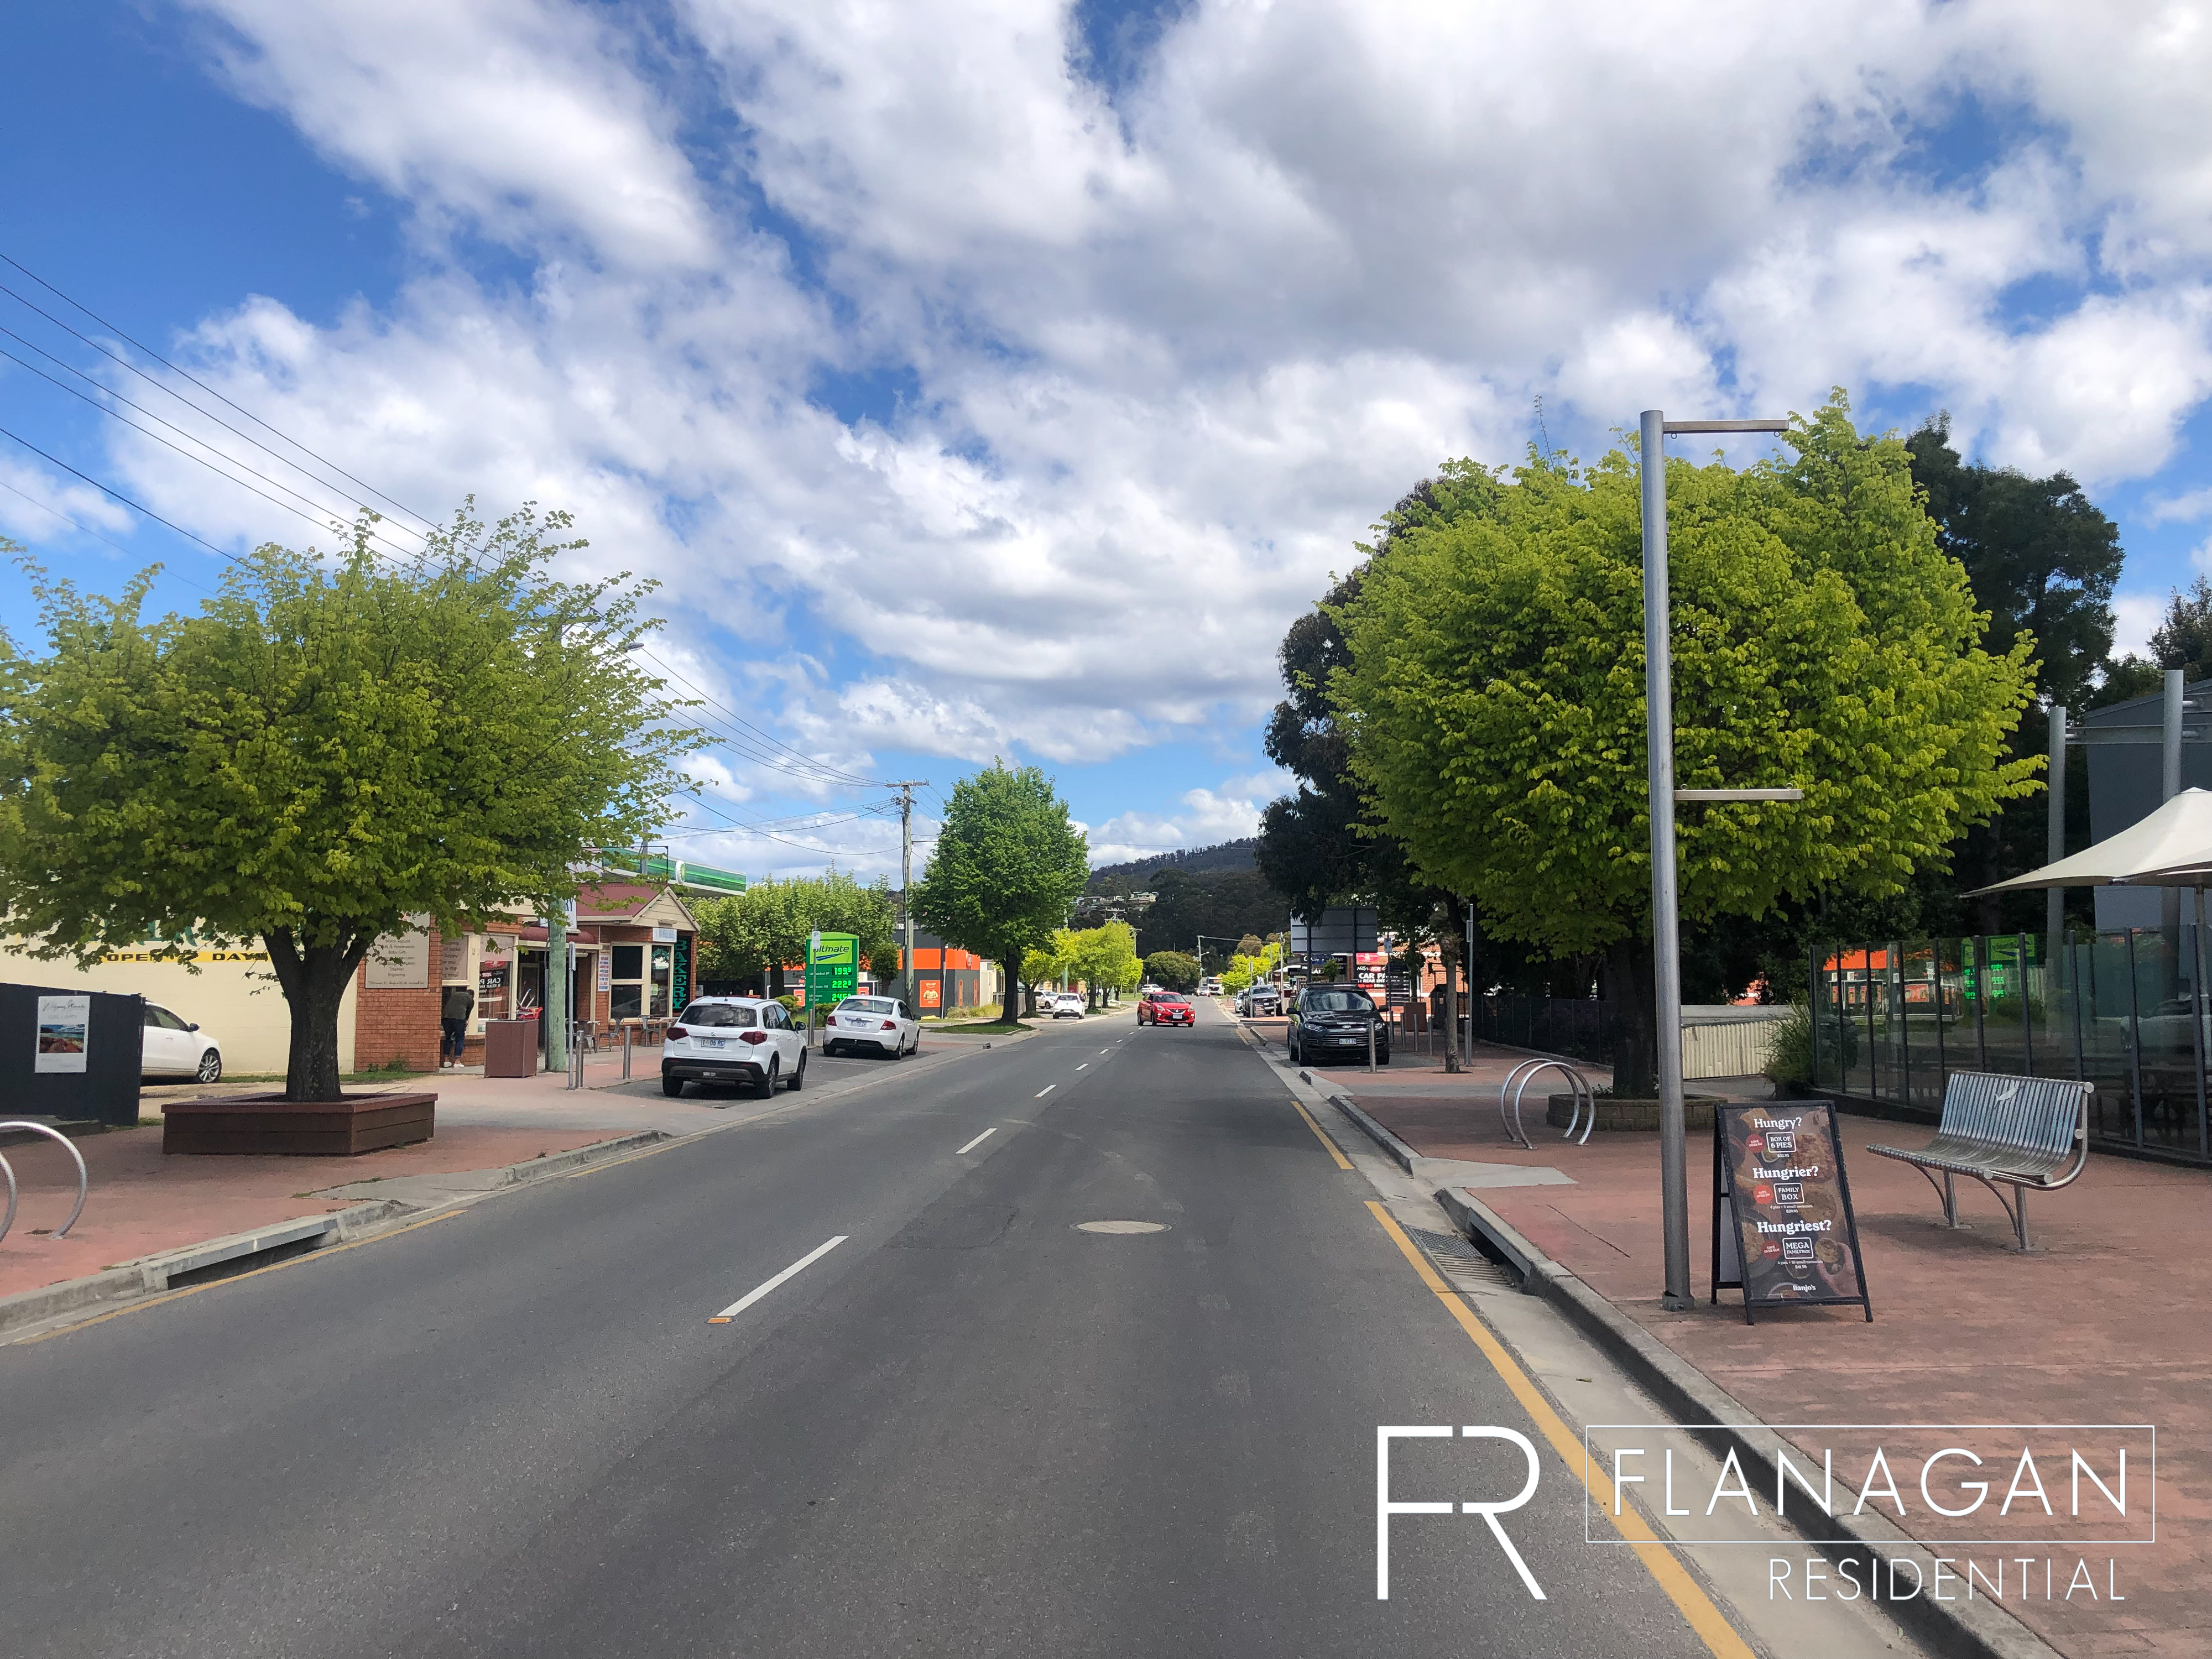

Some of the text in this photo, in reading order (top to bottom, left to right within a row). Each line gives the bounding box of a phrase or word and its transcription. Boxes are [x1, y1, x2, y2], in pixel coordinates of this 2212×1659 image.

[672, 940, 687, 1009] BAKERY
[1753, 1117, 1802, 1130] Hungry?
[1752, 1166, 1819, 1181] Hungrier?
[1756, 1219, 1832, 1235] Hungriest?
